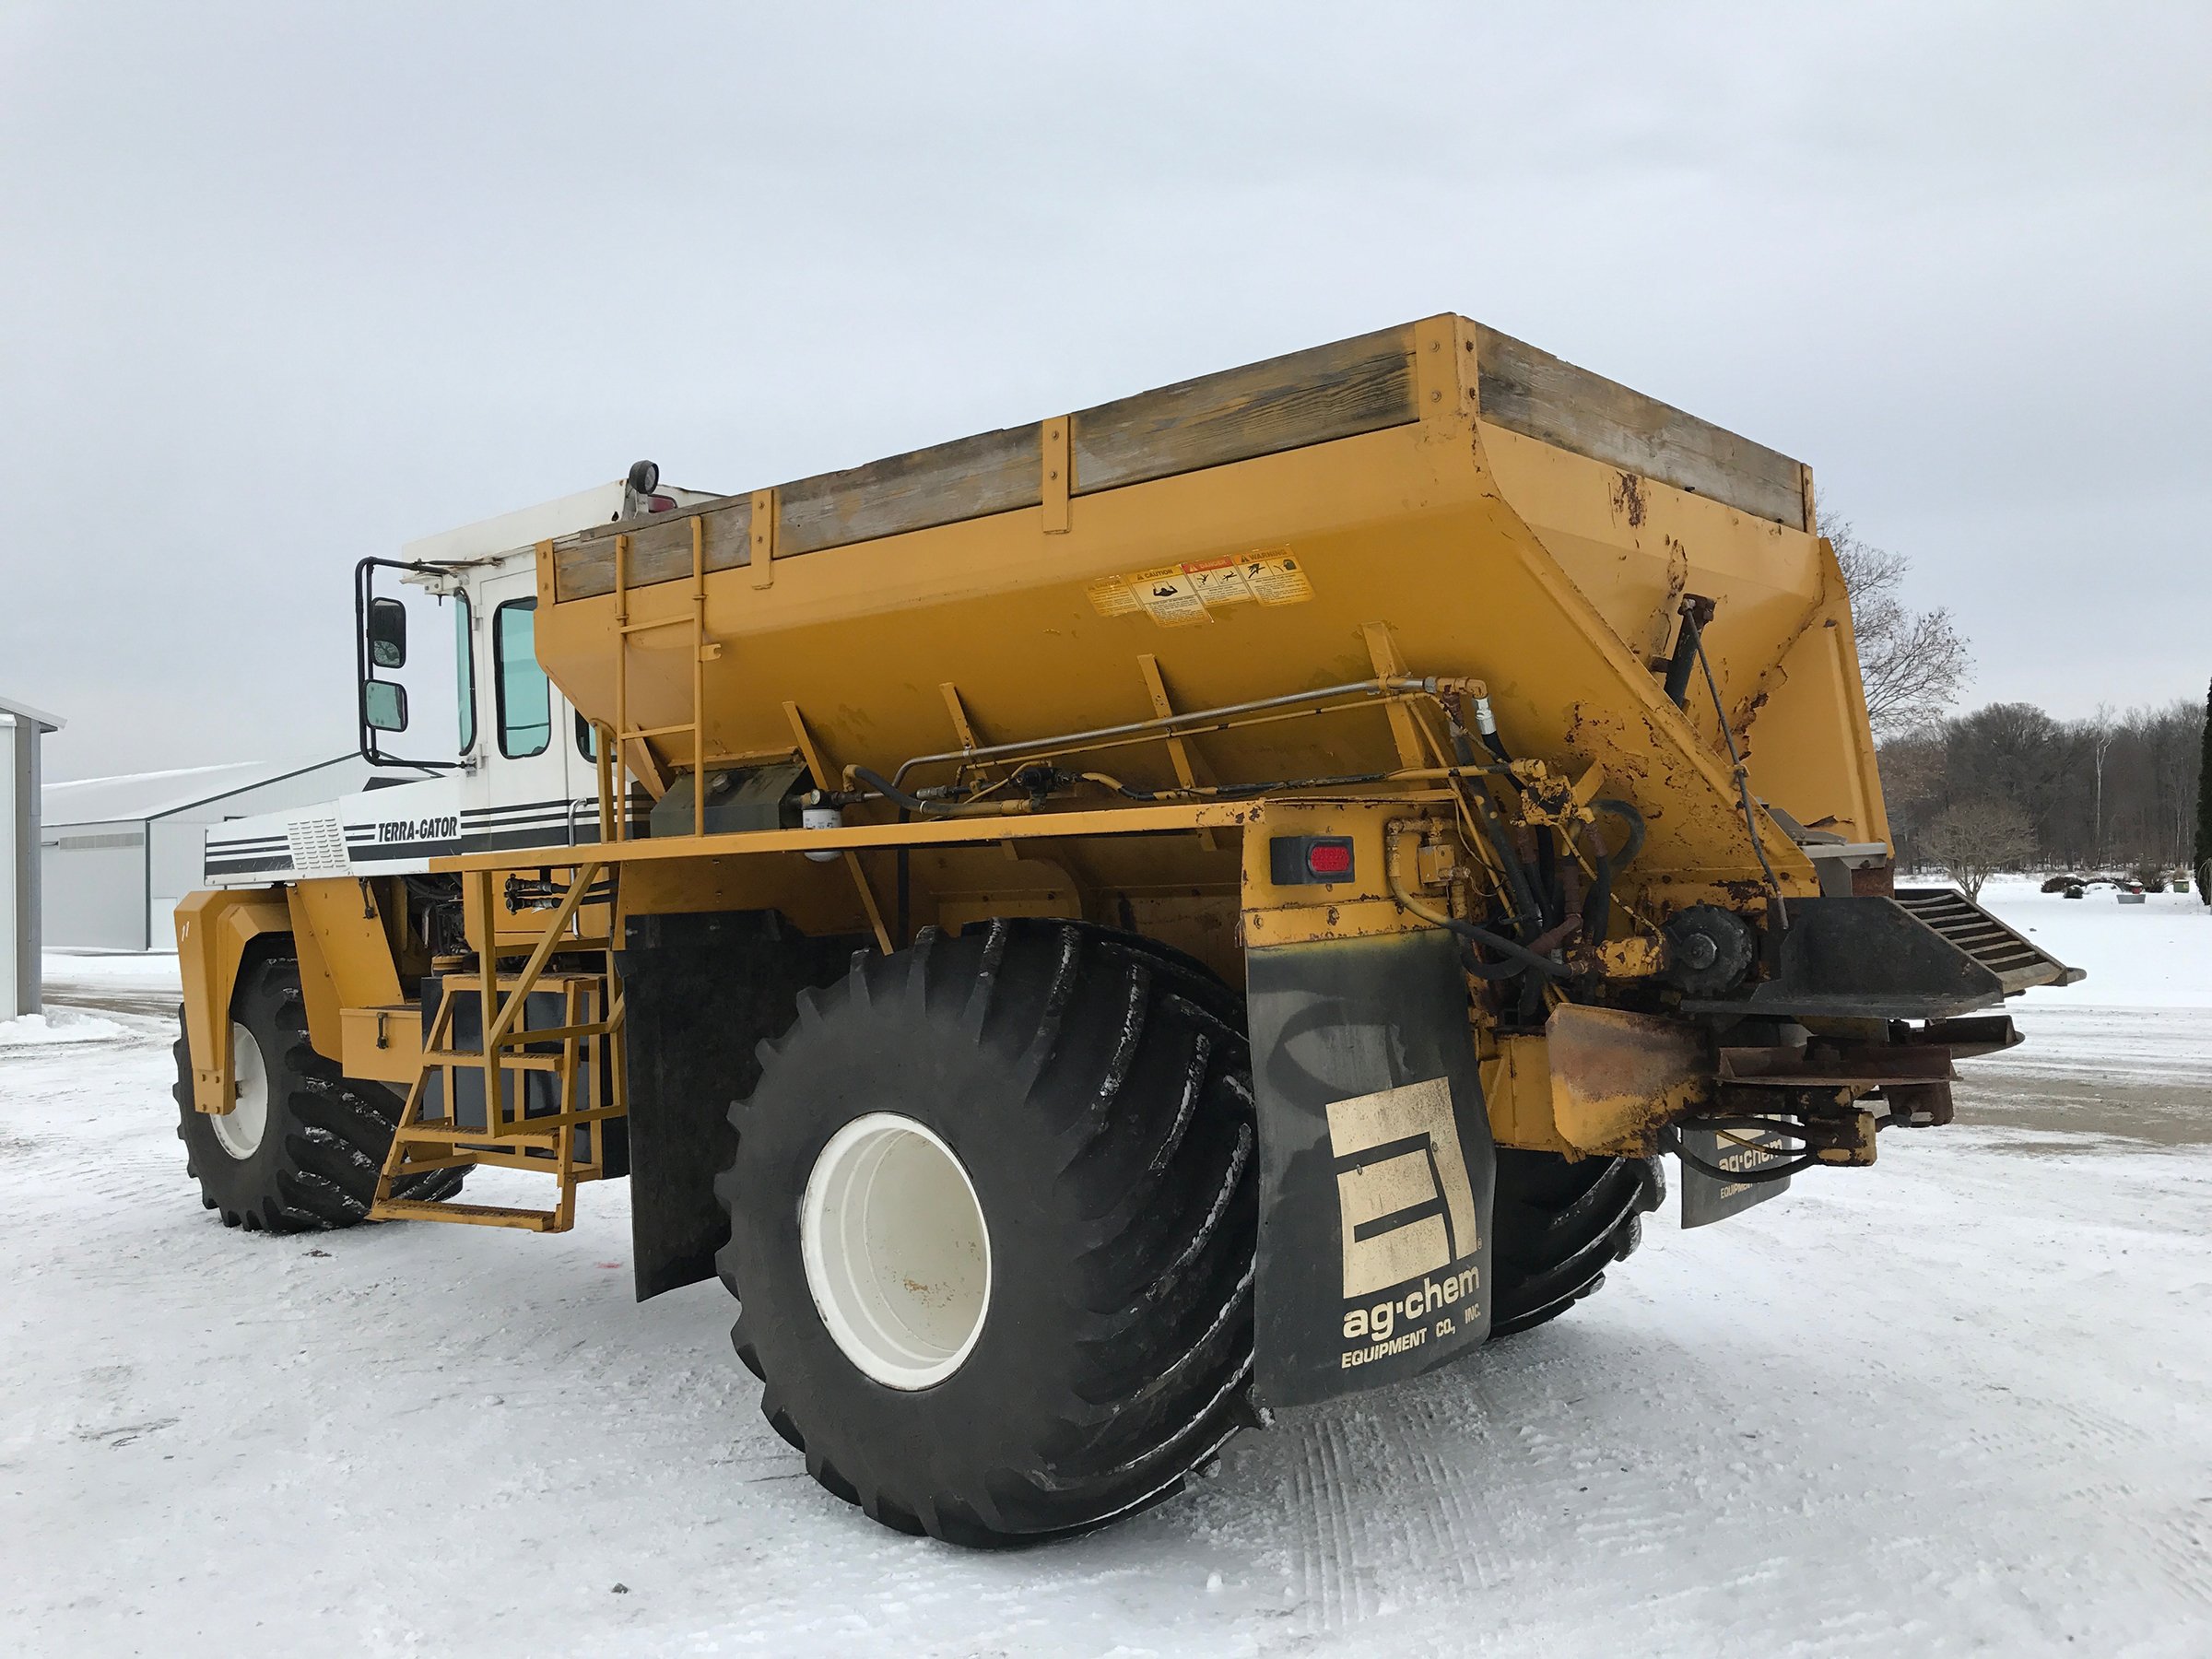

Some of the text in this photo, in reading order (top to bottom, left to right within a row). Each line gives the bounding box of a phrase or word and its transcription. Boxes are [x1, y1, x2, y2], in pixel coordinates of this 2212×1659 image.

[1248, 549, 1288, 560] WARNING
[1199, 559, 1227, 569] DANGER
[1143, 569, 1174, 579] CAUTION
[378, 816, 458, 842] TERRA-GATOR
[1341, 1327, 1428, 1369] EQUIPMENT
[1465, 1302, 1481, 1324] INC.
